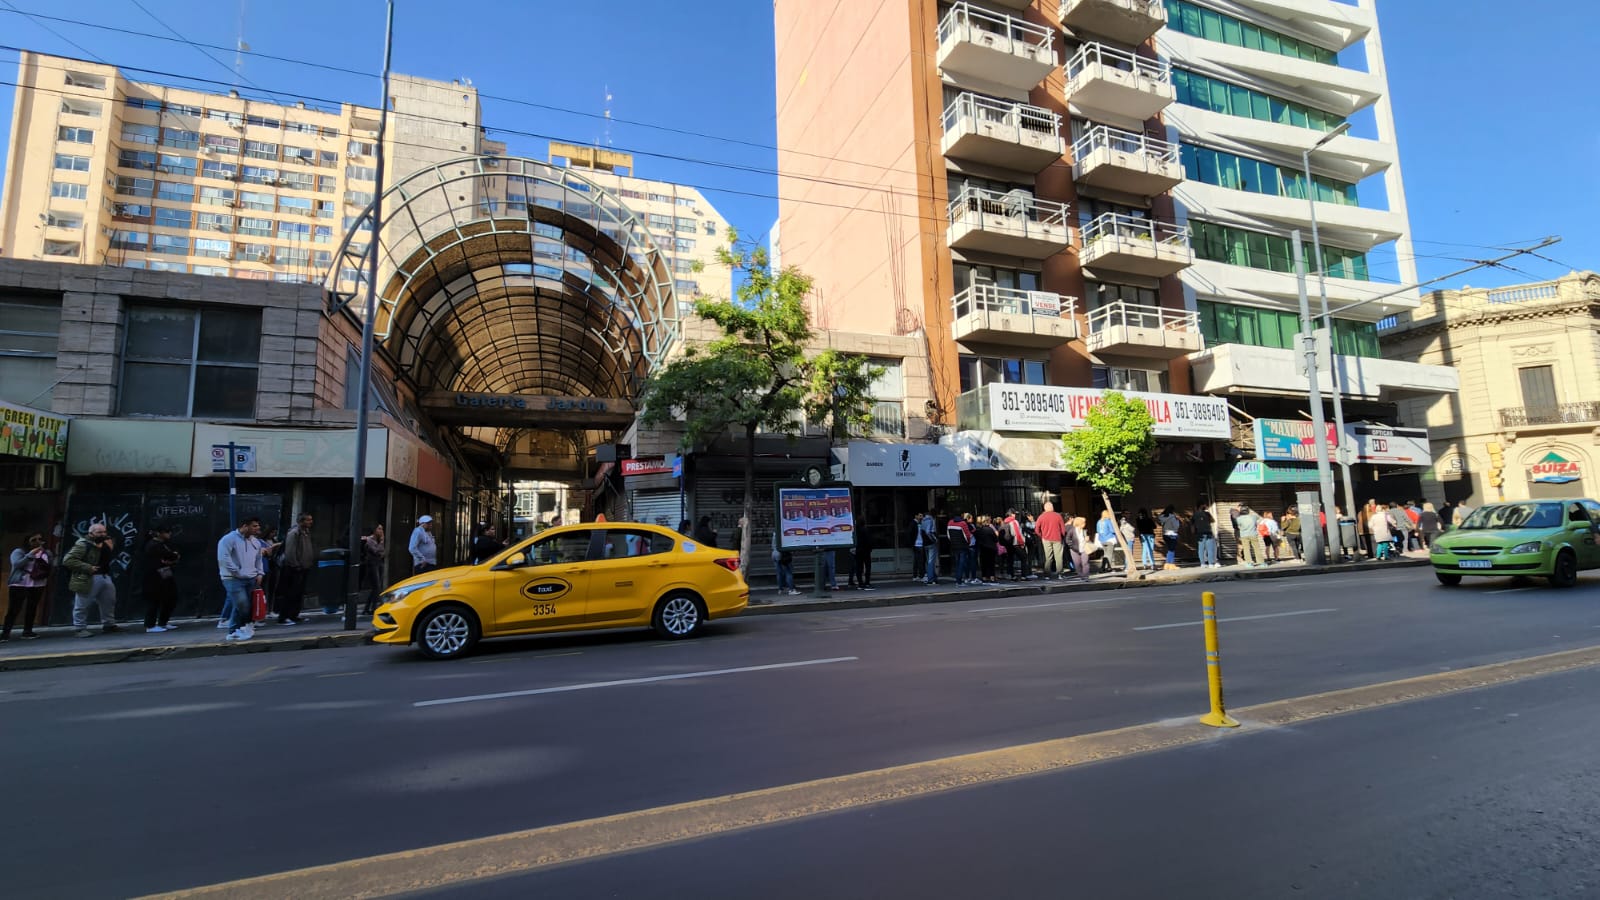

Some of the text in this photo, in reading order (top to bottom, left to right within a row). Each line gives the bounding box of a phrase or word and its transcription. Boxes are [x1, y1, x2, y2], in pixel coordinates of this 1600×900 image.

[1001, 391, 1065, 413] 351-3895405
[1174, 401, 1226, 421] 351-3895405
[1373, 440, 1387, 451] HD
[1532, 462, 1579, 474] SUIZA
[533, 603, 556, 616] 3354
